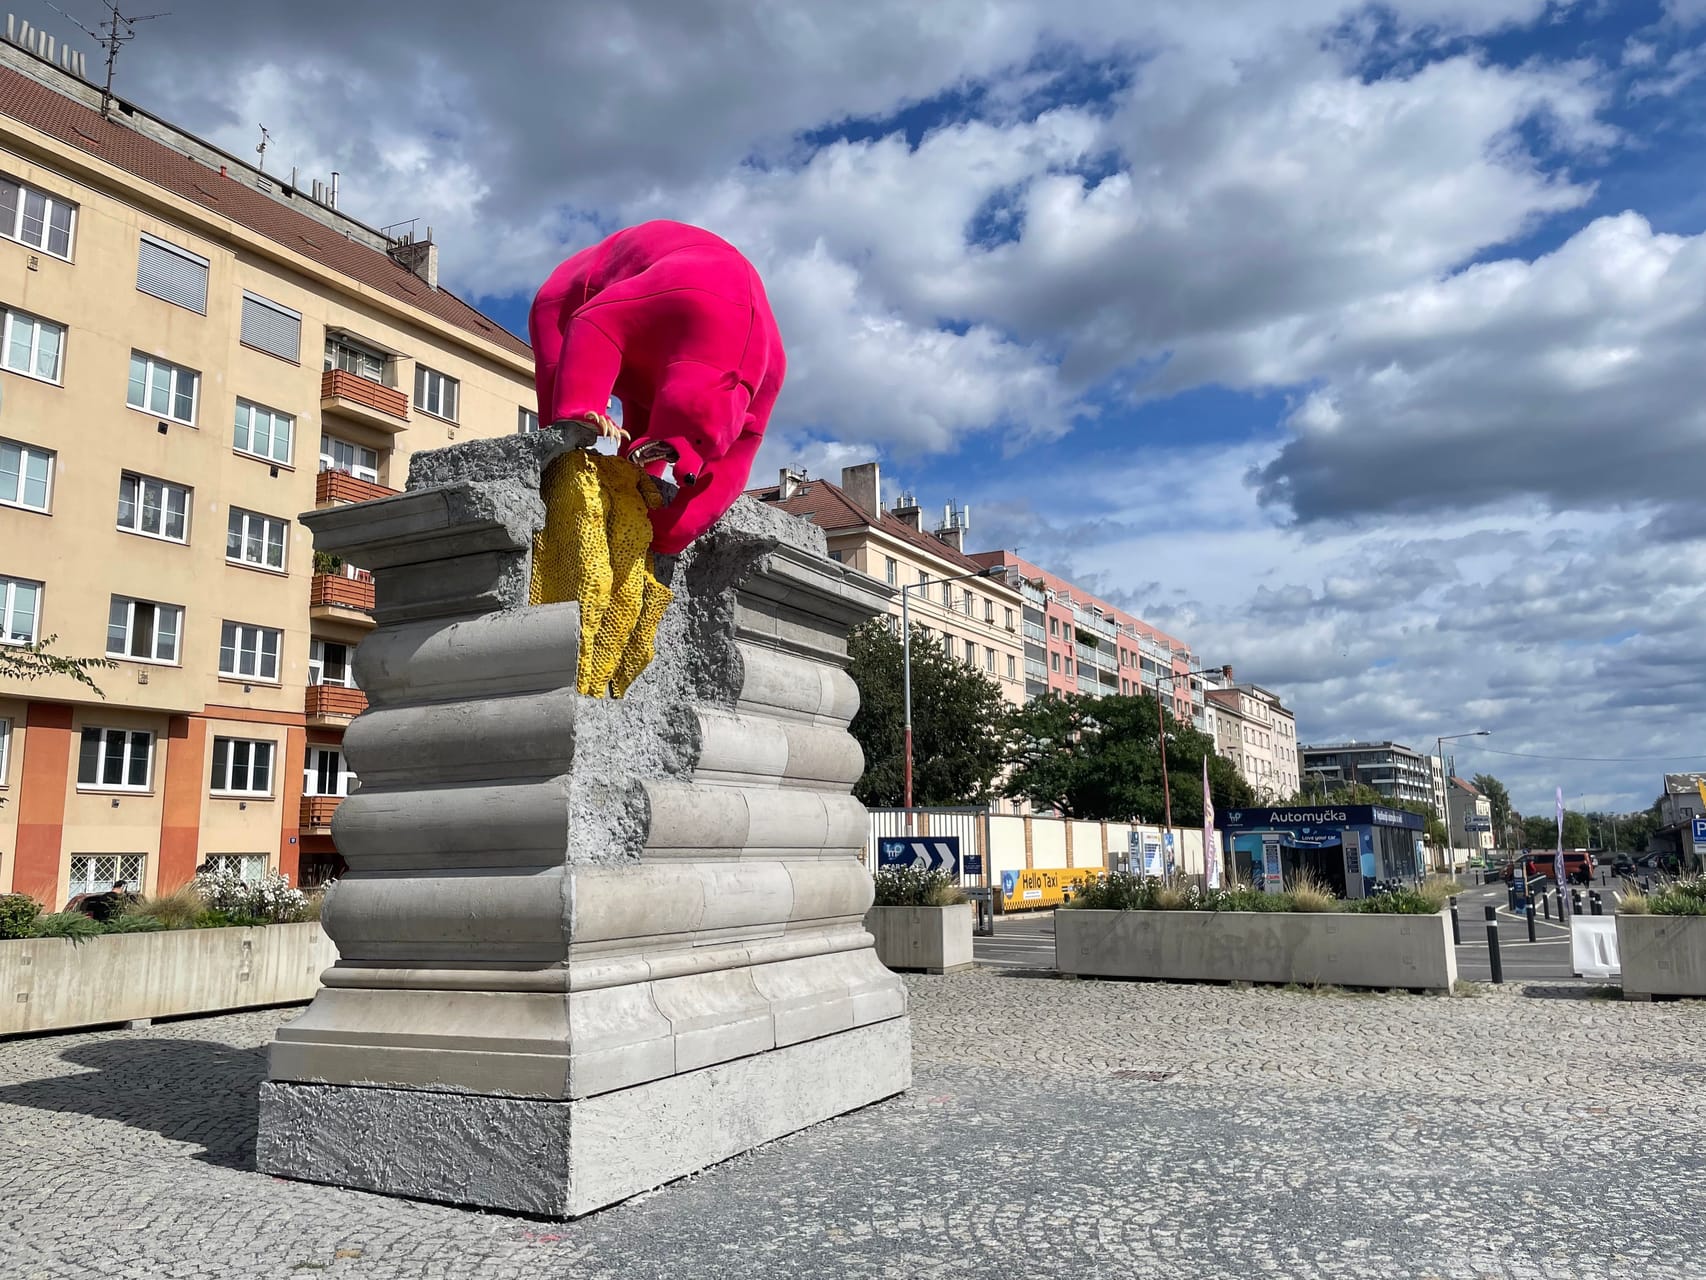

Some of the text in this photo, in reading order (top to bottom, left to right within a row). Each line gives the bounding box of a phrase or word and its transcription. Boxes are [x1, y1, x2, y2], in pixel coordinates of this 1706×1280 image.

[1269, 810, 1347, 824] Automyčka
[1696, 821, 1706, 836] P
[1022, 873, 1042, 889] Hello
[1042, 872, 1058, 888] Taxi
